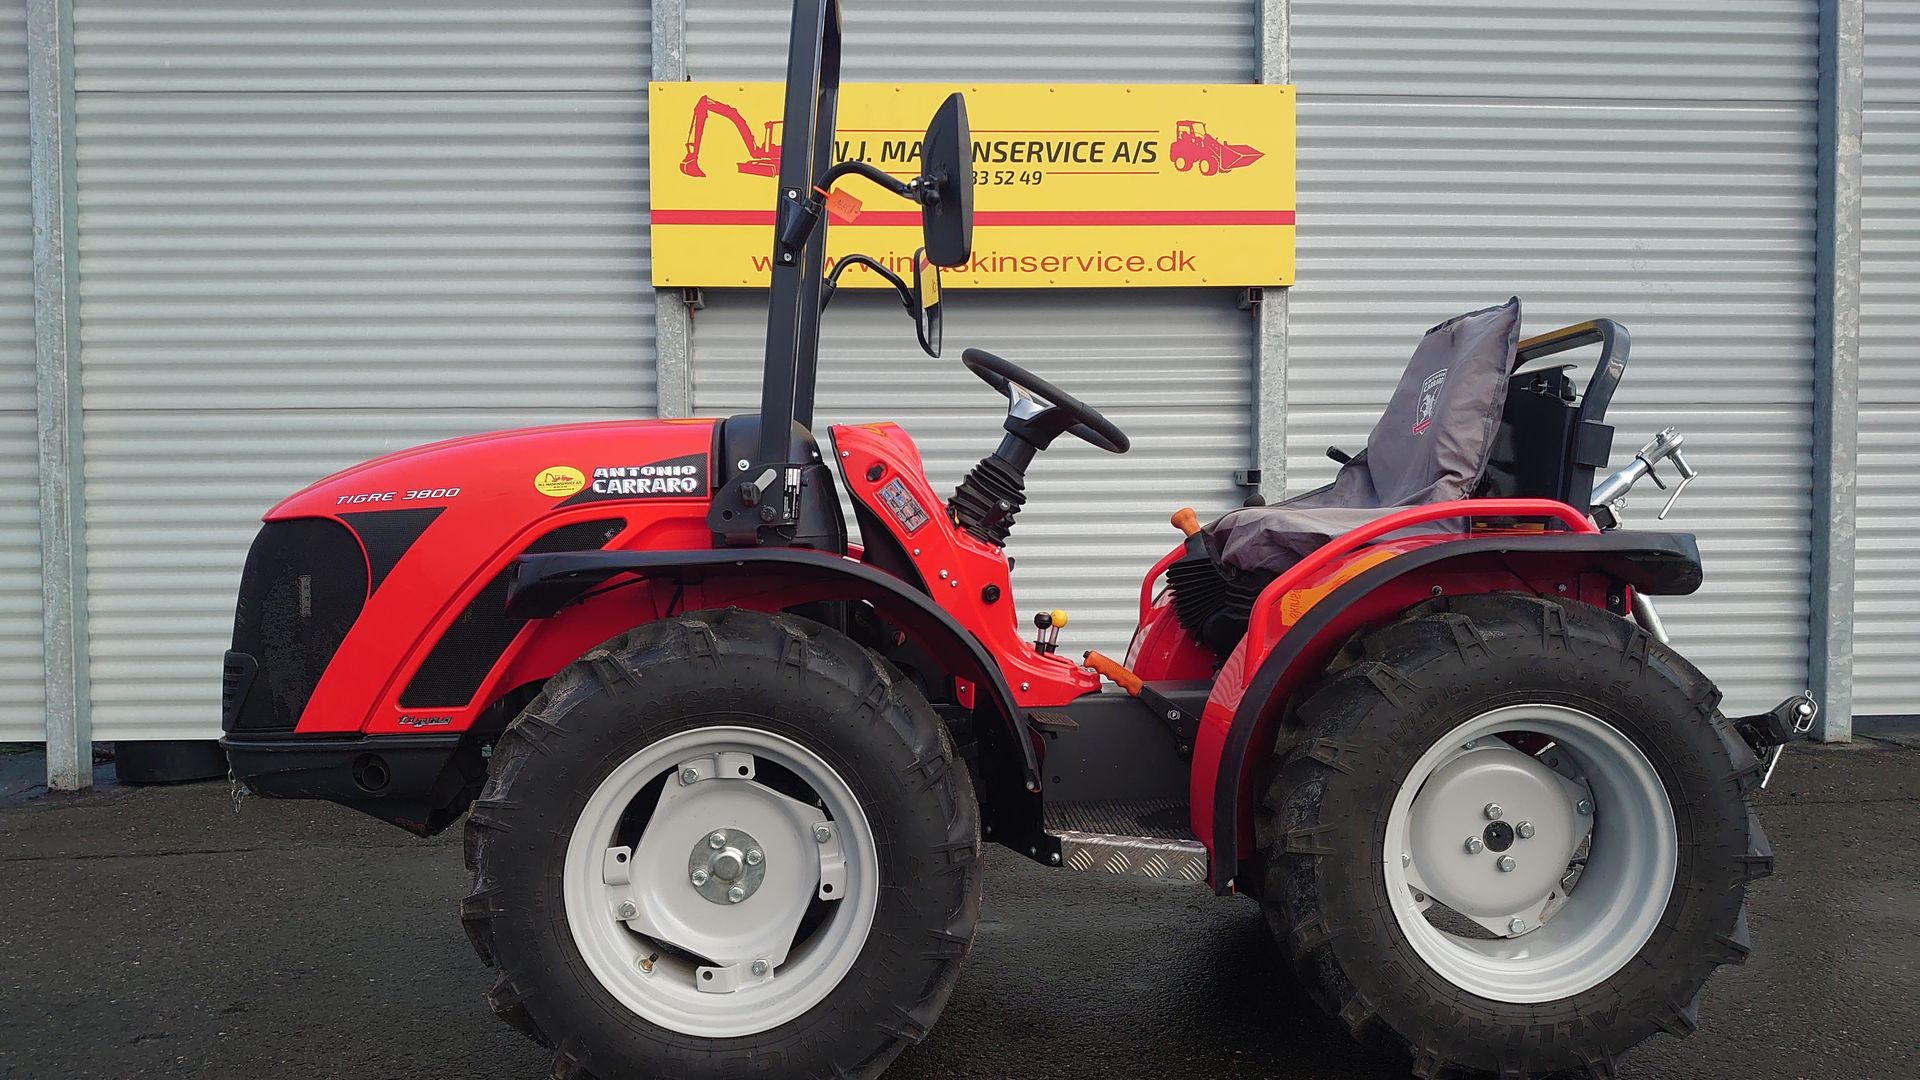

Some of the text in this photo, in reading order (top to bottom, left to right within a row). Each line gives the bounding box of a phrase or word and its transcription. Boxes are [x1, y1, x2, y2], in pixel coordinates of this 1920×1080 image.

[881, 141, 1106, 163] MANSERVICE
[1112, 140, 1158, 164] A/S
[993, 170, 1015, 186] 52
[1019, 170, 1043, 186] 49
[593, 465, 697, 478] ANTONIO
[592, 477, 698, 495] CARRARO
[336, 487, 461, 505] TIGRE 3800
